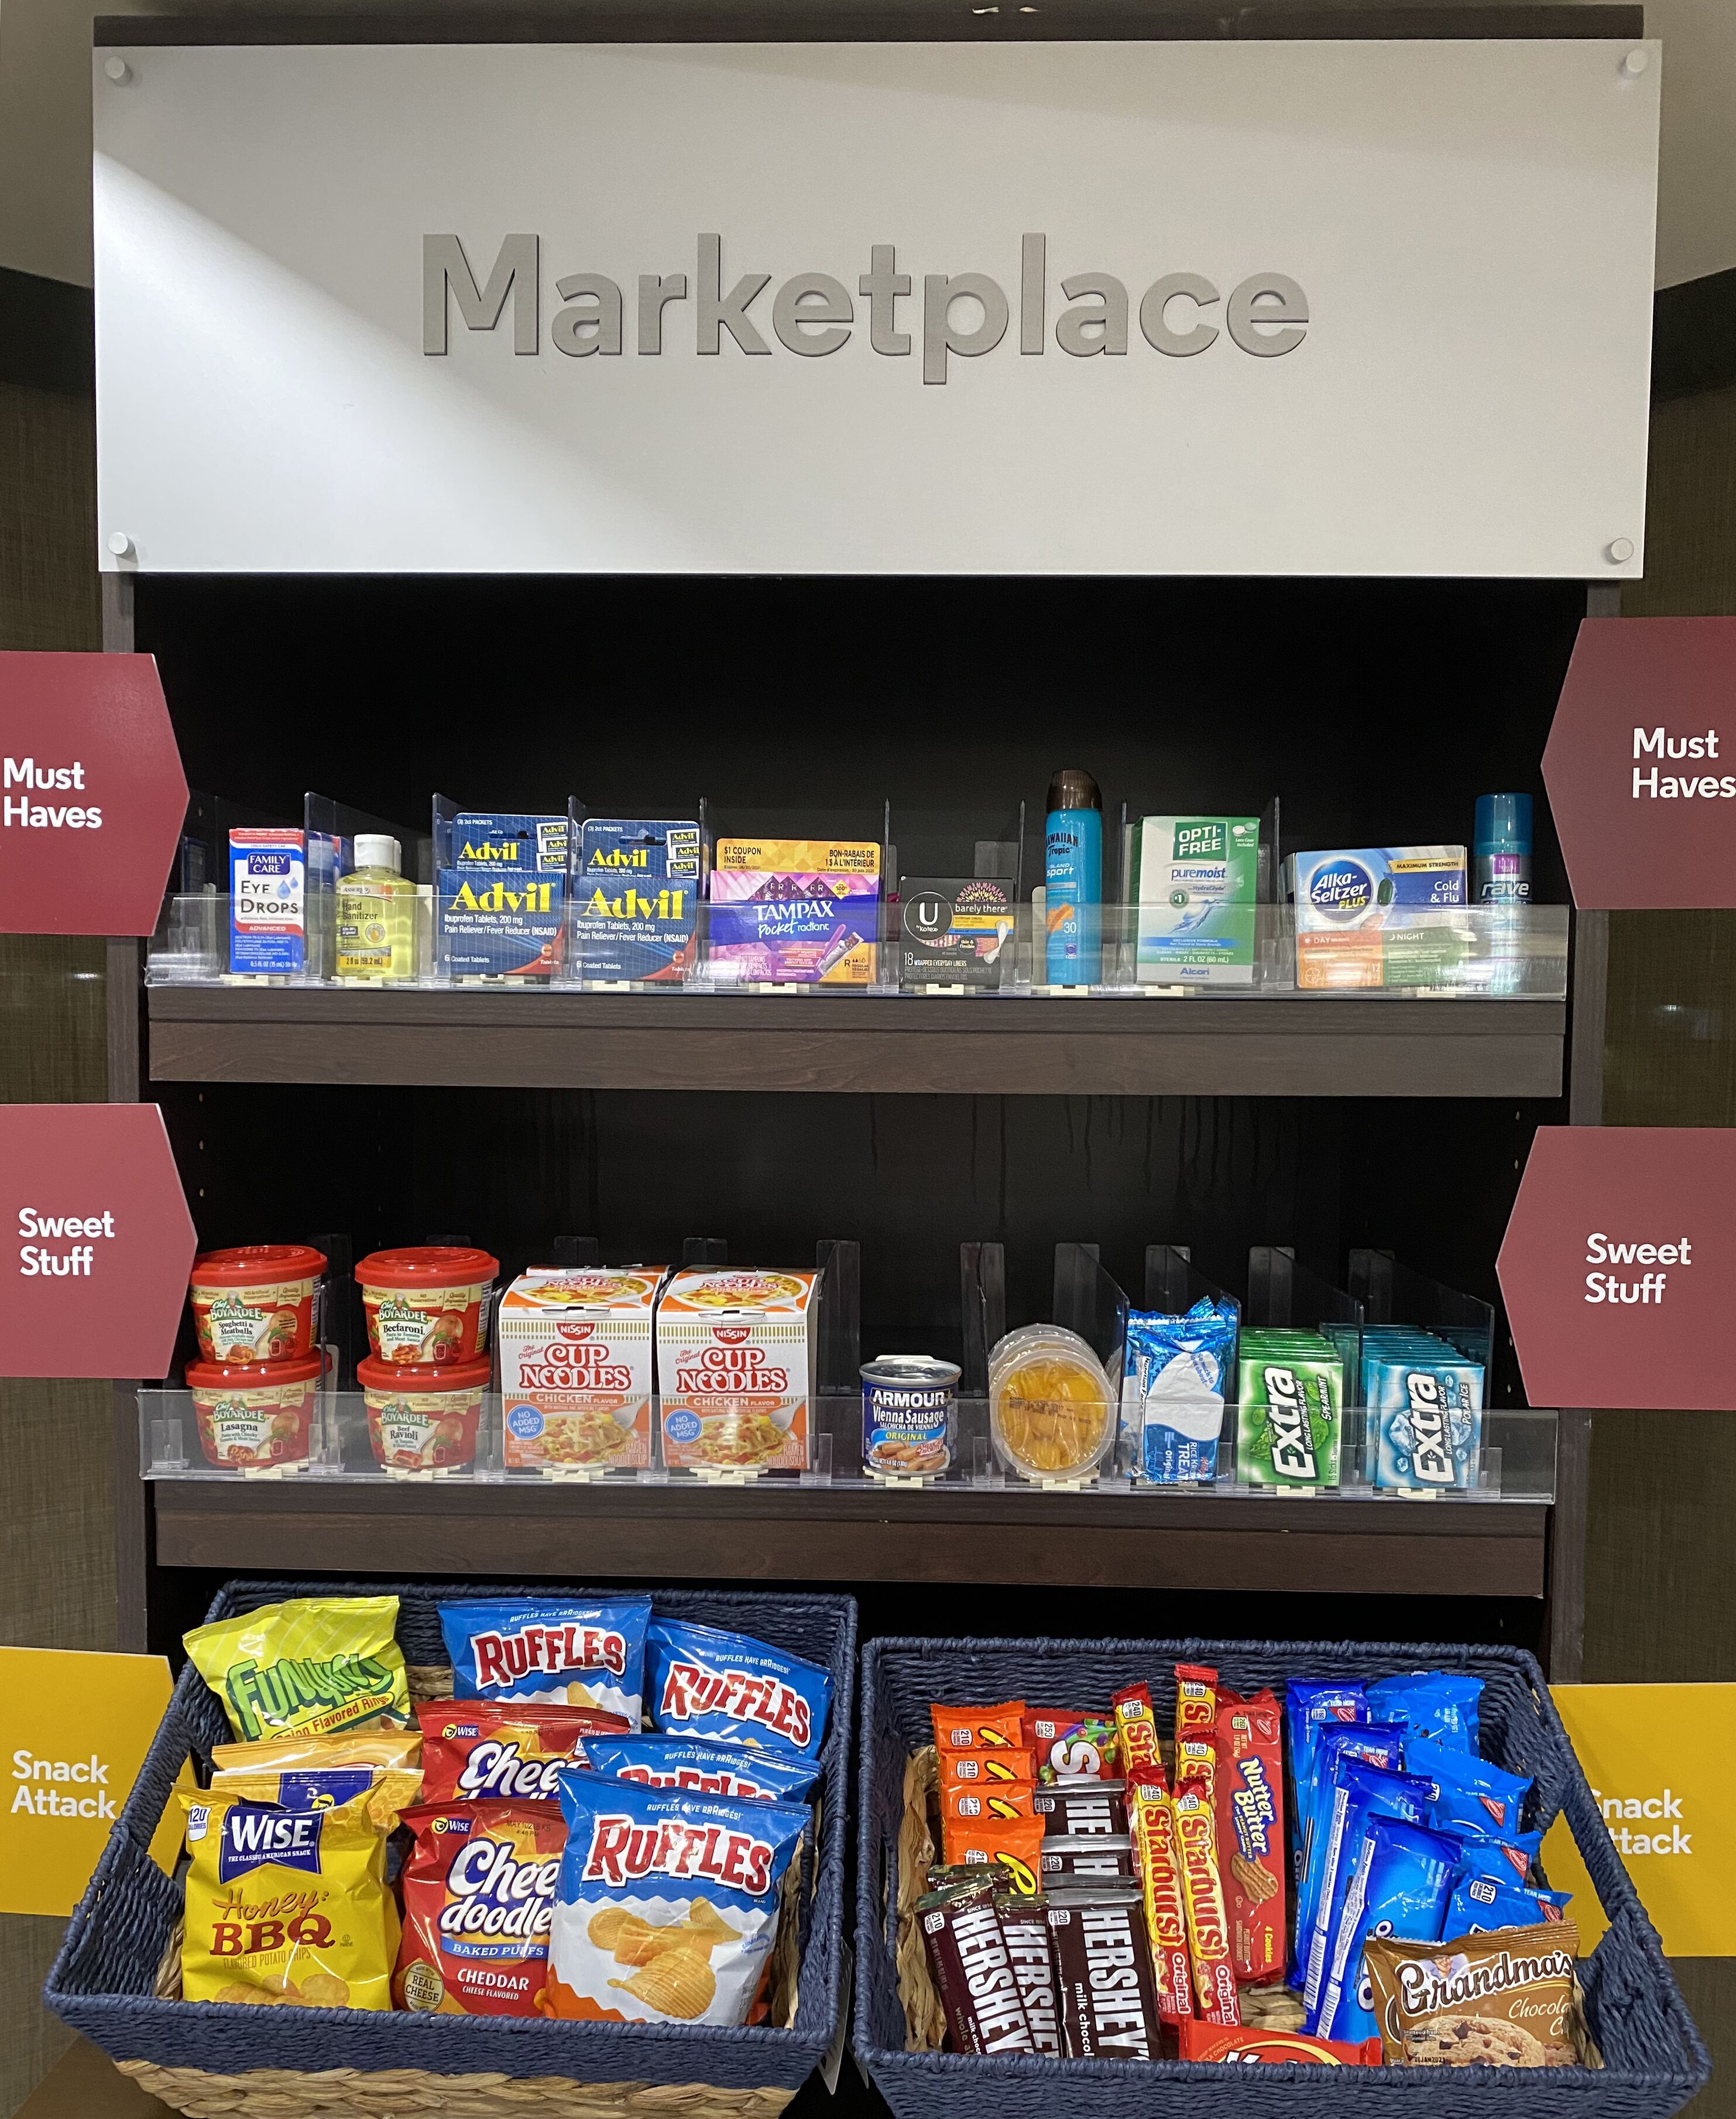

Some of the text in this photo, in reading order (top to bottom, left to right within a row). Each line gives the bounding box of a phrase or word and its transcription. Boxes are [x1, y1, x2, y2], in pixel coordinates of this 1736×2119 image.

[423, 232, 1309, 385] Marketplace
[1633, 727, 1719, 759] Must
[4, 757, 85, 790] Must
[1632, 767, 1736, 798] Haves
[4, 796, 102, 829] Haves
[543, 825, 564, 834] Advil
[673, 832, 695, 841] Advil
[1178, 825, 1222, 842] OPTI-
[458, 841, 518, 860] Advil
[1048, 844, 1070, 857] Tropic
[1179, 838, 1222, 856] FREE
[250, 855, 286, 864] FAMILY
[543, 855, 564, 863] Advil
[588, 848, 647, 867] Advil
[253, 865, 282, 873] CARE
[1047, 866, 1074, 879] sport
[1172, 866, 1226, 881] puremoist
[241, 880, 270, 894] EYE
[1314, 873, 1357, 891] Alka-
[1434, 880, 1459, 891] Cold
[1481, 881, 1529, 897] rave
[448, 881, 551, 913] Advil
[581, 887, 684, 920] Advil
[1310, 883, 1367, 905] Seltzer
[1339, 896, 1366, 910] PLUS
[1430, 893, 1459, 903] & Flu
[241, 899, 299, 914] DROPS
[343, 912, 378, 920] Sanitizer
[753, 901, 835, 921] TAMPAX
[920, 902, 938, 925] U
[955, 904, 1006, 914] barely there
[445, 914, 523, 925] Ibuprofen Tablets, 200 mg
[577, 921, 655, 932] Ibuprofen Tablets, 200 mg
[758, 919, 829, 939] pocket radiant
[1063, 922, 1077, 933] 30
[445, 925, 458, 933] Pain
[459, 926, 503, 935] Reliever/Fever
[532, 927, 557, 937] (NSAID)
[577, 931, 689, 943] Pain Reliever/Fever Reducer (NSAID)
[1397, 932, 1424, 941] NIGHT
[904, 952, 914, 966] 18
[18, 1207, 115, 1238] Sweet
[1586, 1233, 1692, 1265] Sweet
[20, 1245, 94, 1276] Stuff
[1584, 1272, 1666, 1304] Stuff
[210, 1306, 263, 1321] BOYARDEE
[379, 1309, 428, 1322] BOYARDEE
[383, 1323, 424, 1335] Beefaroni
[560, 1324, 591, 1335] NISSIN
[716, 1329, 747, 1339] NISSIN
[519, 1347, 544, 1360] Original
[545, 1343, 609, 1367] CUP
[675, 1351, 701, 1364] Original
[702, 1347, 765, 1371] CUP
[519, 1364, 632, 1390] NOODLES
[677, 1369, 787, 1394] NOODLES
[536, 1393, 591, 1404] CHICKEN
[694, 1397, 749, 1407] CHICKEN
[873, 1390, 945, 1408] ARMOUR
[1318, 1376, 1332, 1421] SPEARMINT
[1438, 1386, 1447, 1410] FLAVOR
[1460, 1384, 1471, 1425] POLAR ICE
[213, 1410, 265, 1422] BOYARDEE
[381, 1412, 429, 1427] BOYARDEE
[513, 1417, 539, 1426] ADDED
[873, 1405, 944, 1428] Vienna Sausage
[1264, 1367, 1316, 1478] Extra
[1296, 1380, 1314, 1451] LONG LASTING FLAVOR
[1442, 1410, 1451, 1436] LASTING
[221, 1423, 258, 1432] Lasagna
[390, 1431, 418, 1441] Ravioli
[671, 1421, 697, 1432] ADDED
[1408, 1373, 1454, 1482] Extra
[886, 1432, 927, 1441] ORIGINAL
[473, 1626, 625, 1685] RUFFLES
[662, 1664, 809, 1744] RUFFLES
[313, 1703, 360, 1733] Flavored
[363, 1695, 390, 1711] Rings
[457, 1726, 477, 1737] WISE
[12, 1750, 109, 1784] Snack
[460, 1742, 567, 1796] Chee
[1240, 1757, 1274, 1822] Nutter
[11, 1785, 117, 1820] Attack
[450, 1820, 469, 1832] WISE
[1234, 1789, 1267, 1853] Butter
[231, 1815, 313, 1852] WISE
[1608, 1825, 1693, 1854] tack
[239, 1854, 262, 1862] CLASSIC
[262, 1851, 291, 1859] AMERICAN
[587, 1817, 771, 1892] RUFFLES
[450, 1840, 560, 1903] Chee
[1144, 1808, 1186, 1946] Starburst
[1181, 1818, 1227, 1959] Starburst
[1481, 1886, 1494, 1903] 210
[440, 1897, 553, 1935] doodle
[210, 1913, 336, 1956] BBQ
[452, 1943, 544, 1956] BAKED PUFFS
[1264, 1933, 1274, 1963] Cookies
[224, 1951, 287, 1969] FLAVORED POTATO
[412, 1974, 434, 1991] REAL
[457, 1968, 529, 1991] CHEDDAR
[1172, 1953, 1191, 2014] Original
[1395, 1951, 1573, 2014] Grandma's
[406, 1984, 440, 2003] CHEESE
[462, 1986, 519, 2001] CHEESE FLAVORED
[1215, 1966, 1239, 2027] Original
[955, 2006, 968, 2042] whole
[1213, 2036, 1244, 2057] CHOCOLATE
